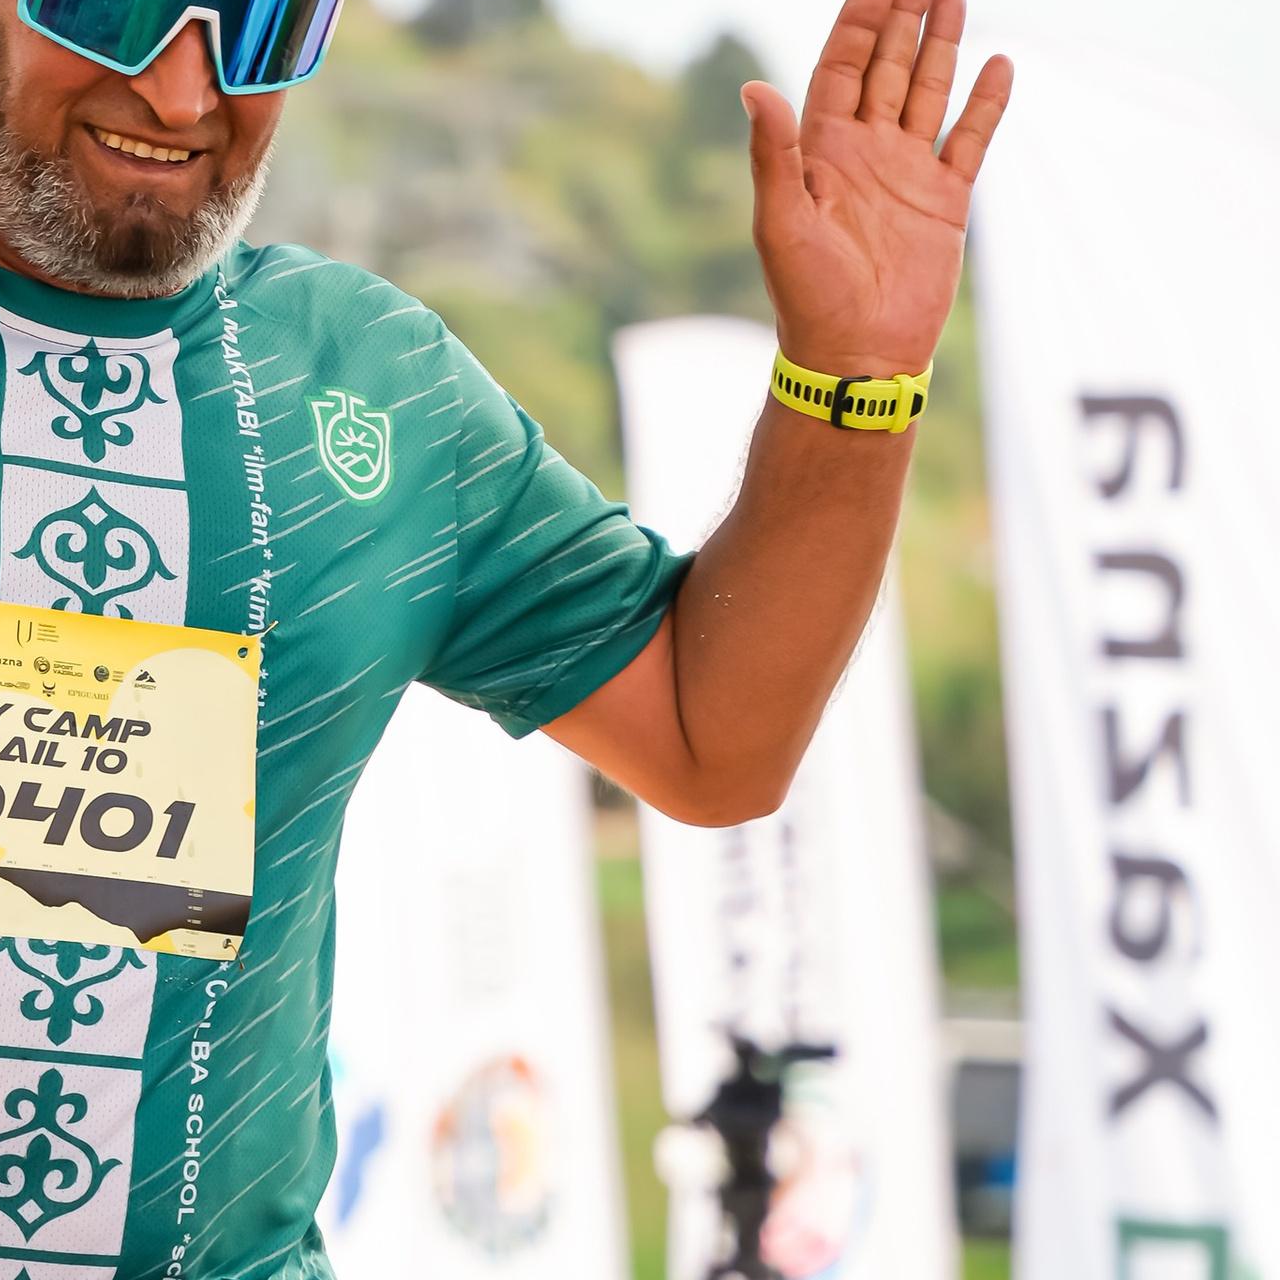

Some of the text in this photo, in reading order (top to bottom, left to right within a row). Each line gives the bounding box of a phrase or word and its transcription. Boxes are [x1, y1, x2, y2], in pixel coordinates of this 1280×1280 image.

[221, 316, 262, 438] MAKTABI
[53, 663, 74, 671] SPORT
[23, 706, 152, 744] CAMP
[80, 745, 128, 775] 10
[176, 1093, 204, 1225] SCHOOL
